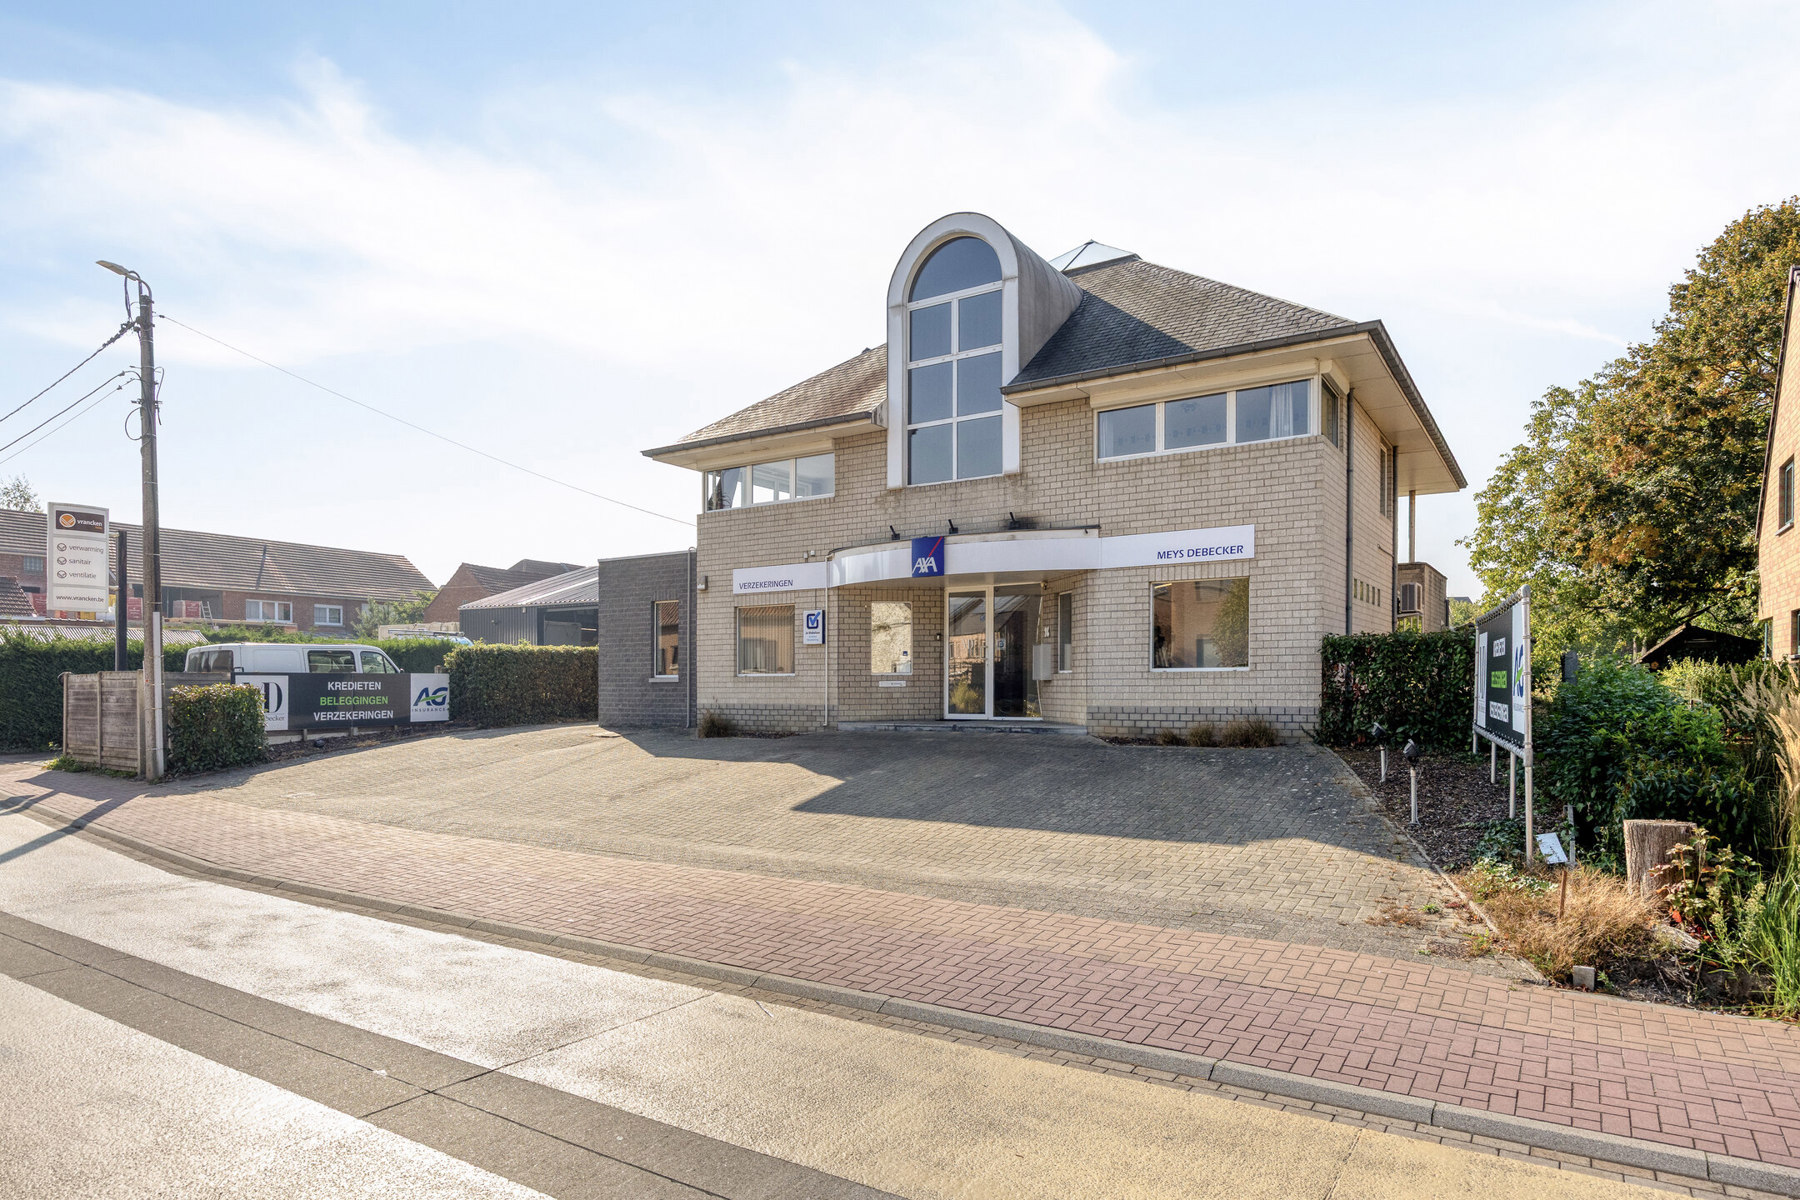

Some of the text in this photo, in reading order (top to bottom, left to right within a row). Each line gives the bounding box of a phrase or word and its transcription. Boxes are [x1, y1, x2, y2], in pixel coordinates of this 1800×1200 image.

[77, 519, 103, 527] vrancken
[69, 544, 104, 554] verwarming
[1157, 545, 1244, 559] MEYS DEBECKER
[912, 557, 938, 573] AXA
[69, 571, 96, 579] ventilatie
[739, 580, 793, 590] VERZEKERINGEN
[328, 681, 382, 691] KREDIETEN
[320, 696, 389, 706] BELEGGINGEN
[413, 687, 448, 706] AG
[314, 710, 394, 720] VERZEKERINGEN
